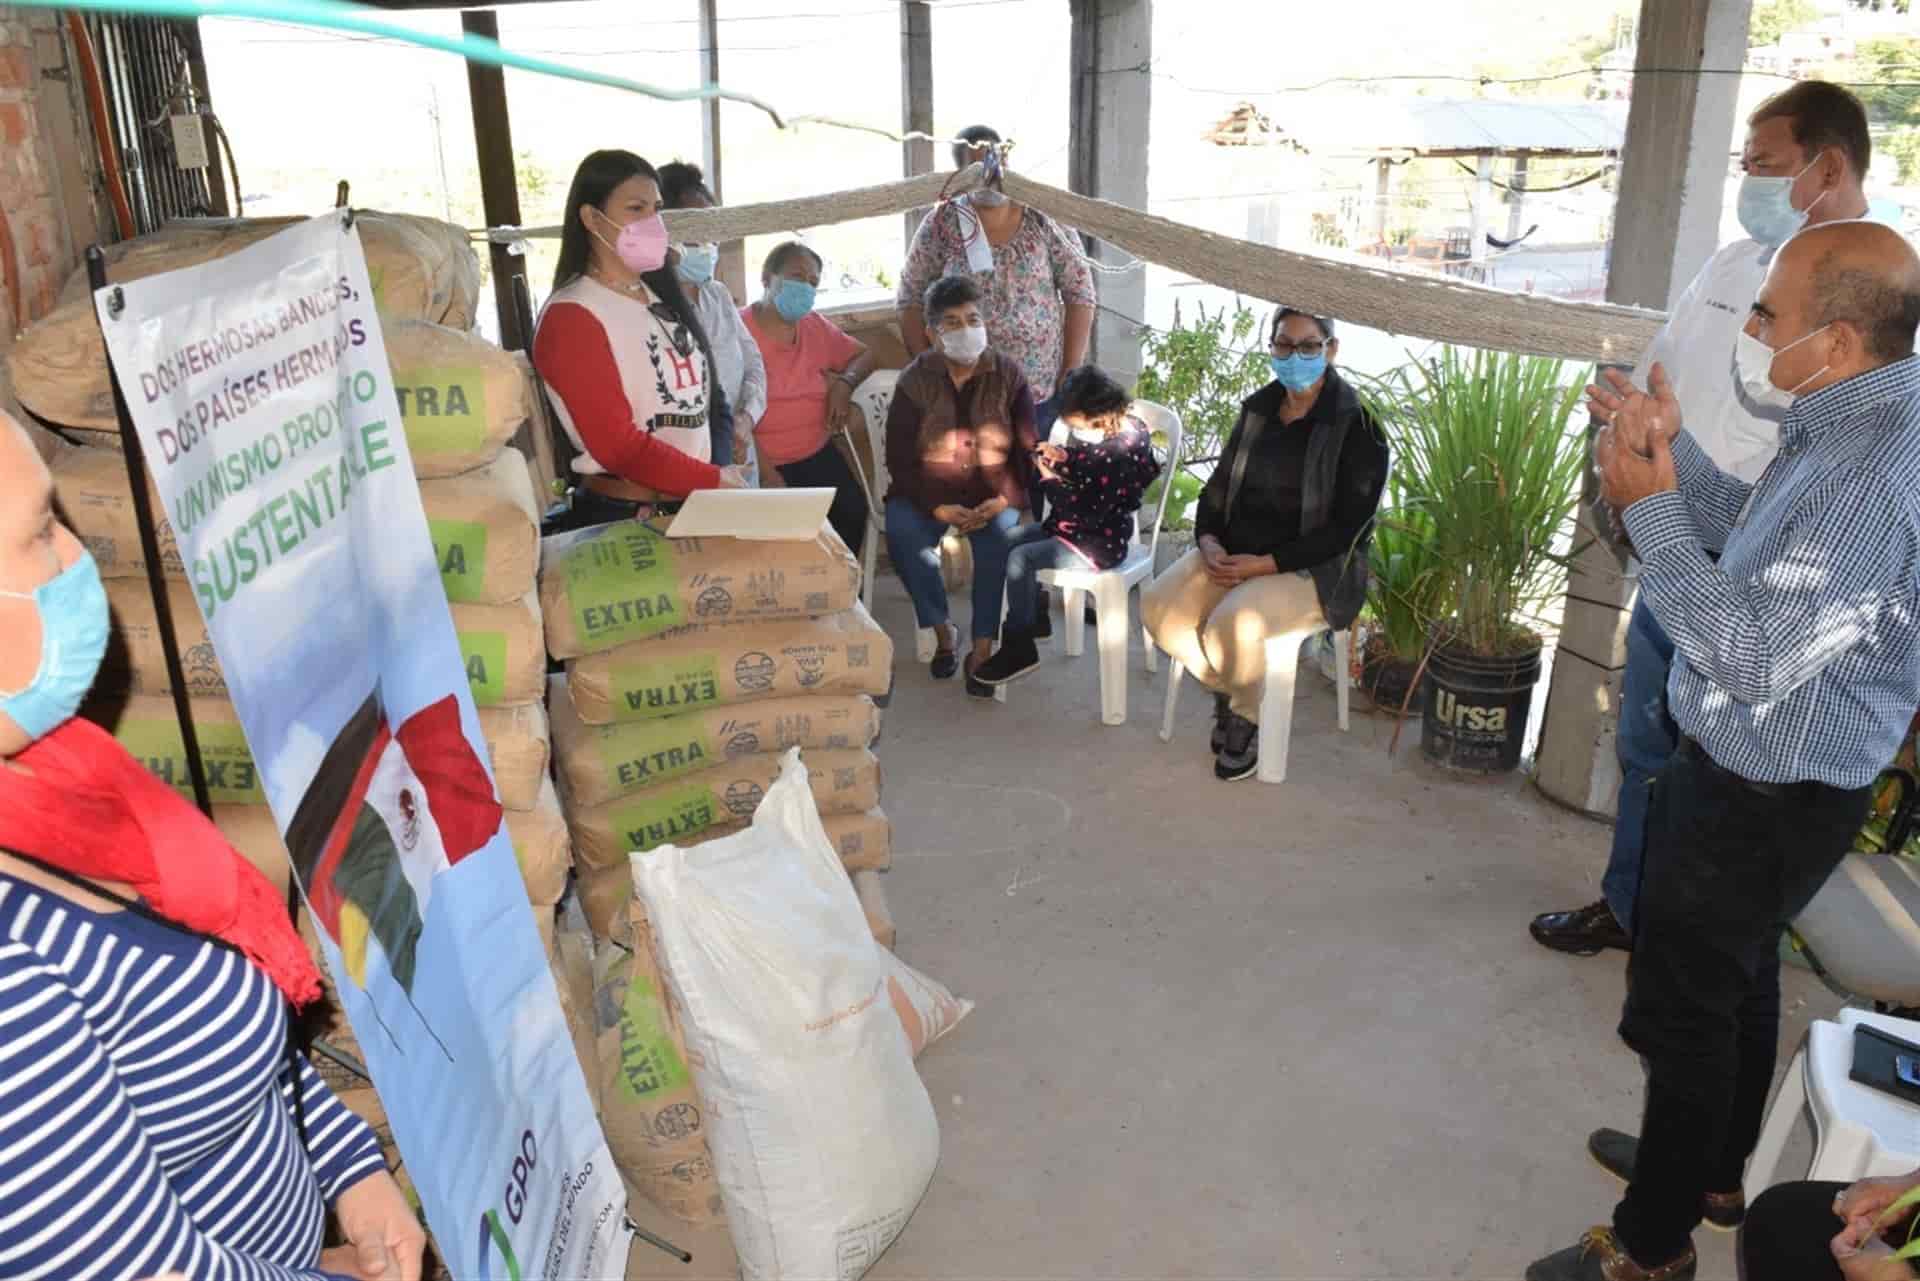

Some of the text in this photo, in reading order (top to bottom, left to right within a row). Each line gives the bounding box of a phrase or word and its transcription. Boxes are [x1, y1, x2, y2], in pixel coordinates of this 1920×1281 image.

[195, 369, 271, 436] PAÍSES
[396, 384, 470, 418] TRA
[176, 369, 377, 534] UN MISMO PROYO
[582, 592, 675, 632] EXTRA
[625, 680, 717, 711] EXTRA
[1437, 687, 1507, 731] Ursa
[136, 757, 254, 789] EXTR
[616, 741, 705, 785] EXTRA
[628, 805, 713, 848] EXTRA
[505, 1129, 537, 1226] GPO
